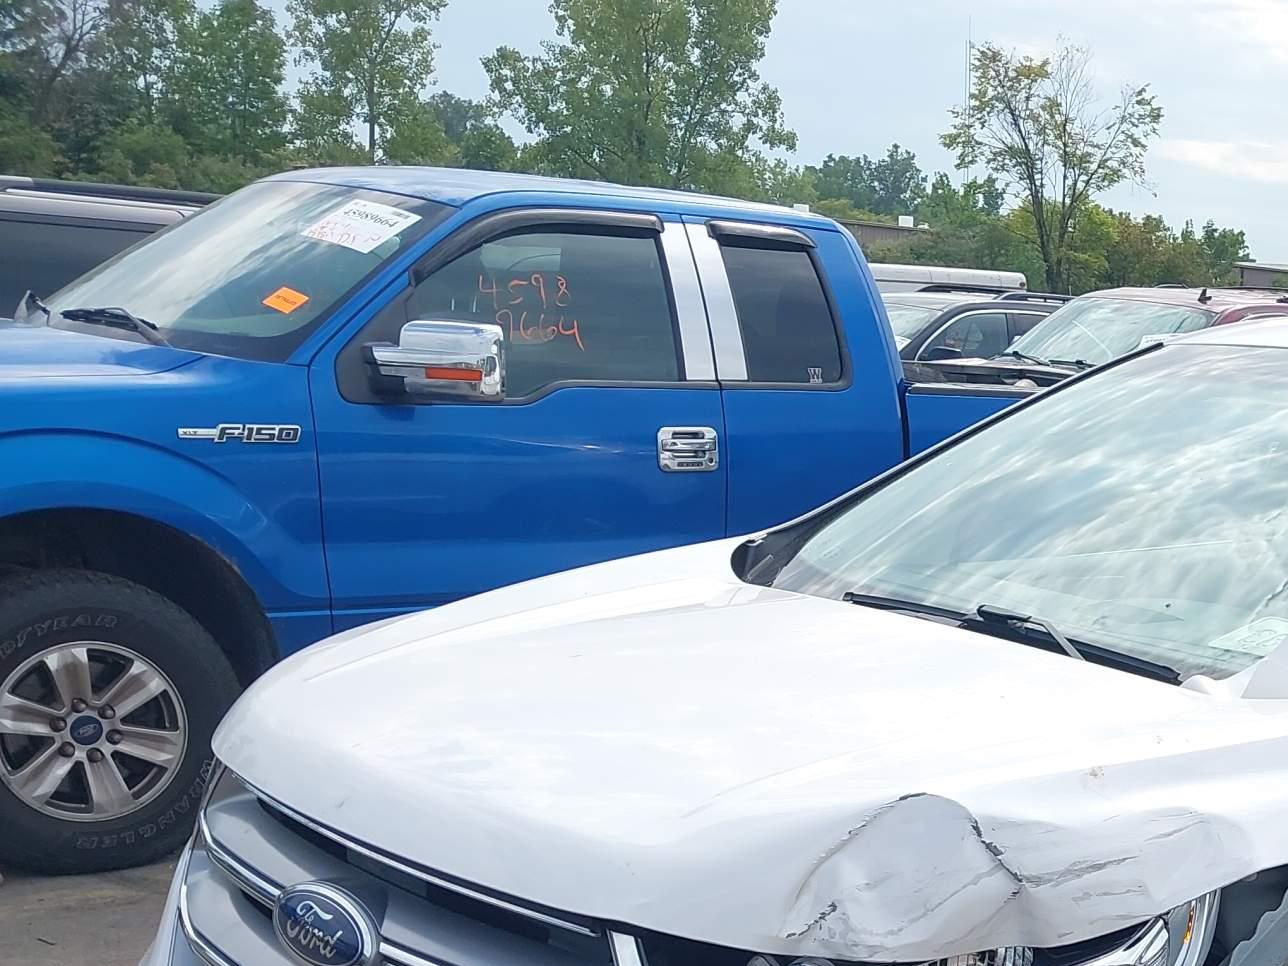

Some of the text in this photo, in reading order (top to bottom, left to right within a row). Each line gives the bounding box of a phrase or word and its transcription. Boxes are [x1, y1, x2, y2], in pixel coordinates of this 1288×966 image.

[480, 273, 572, 310] 4598
[495, 309, 585, 351] 9664
[215, 424, 301, 442] F-150
[286, 900, 344, 959] Ford
